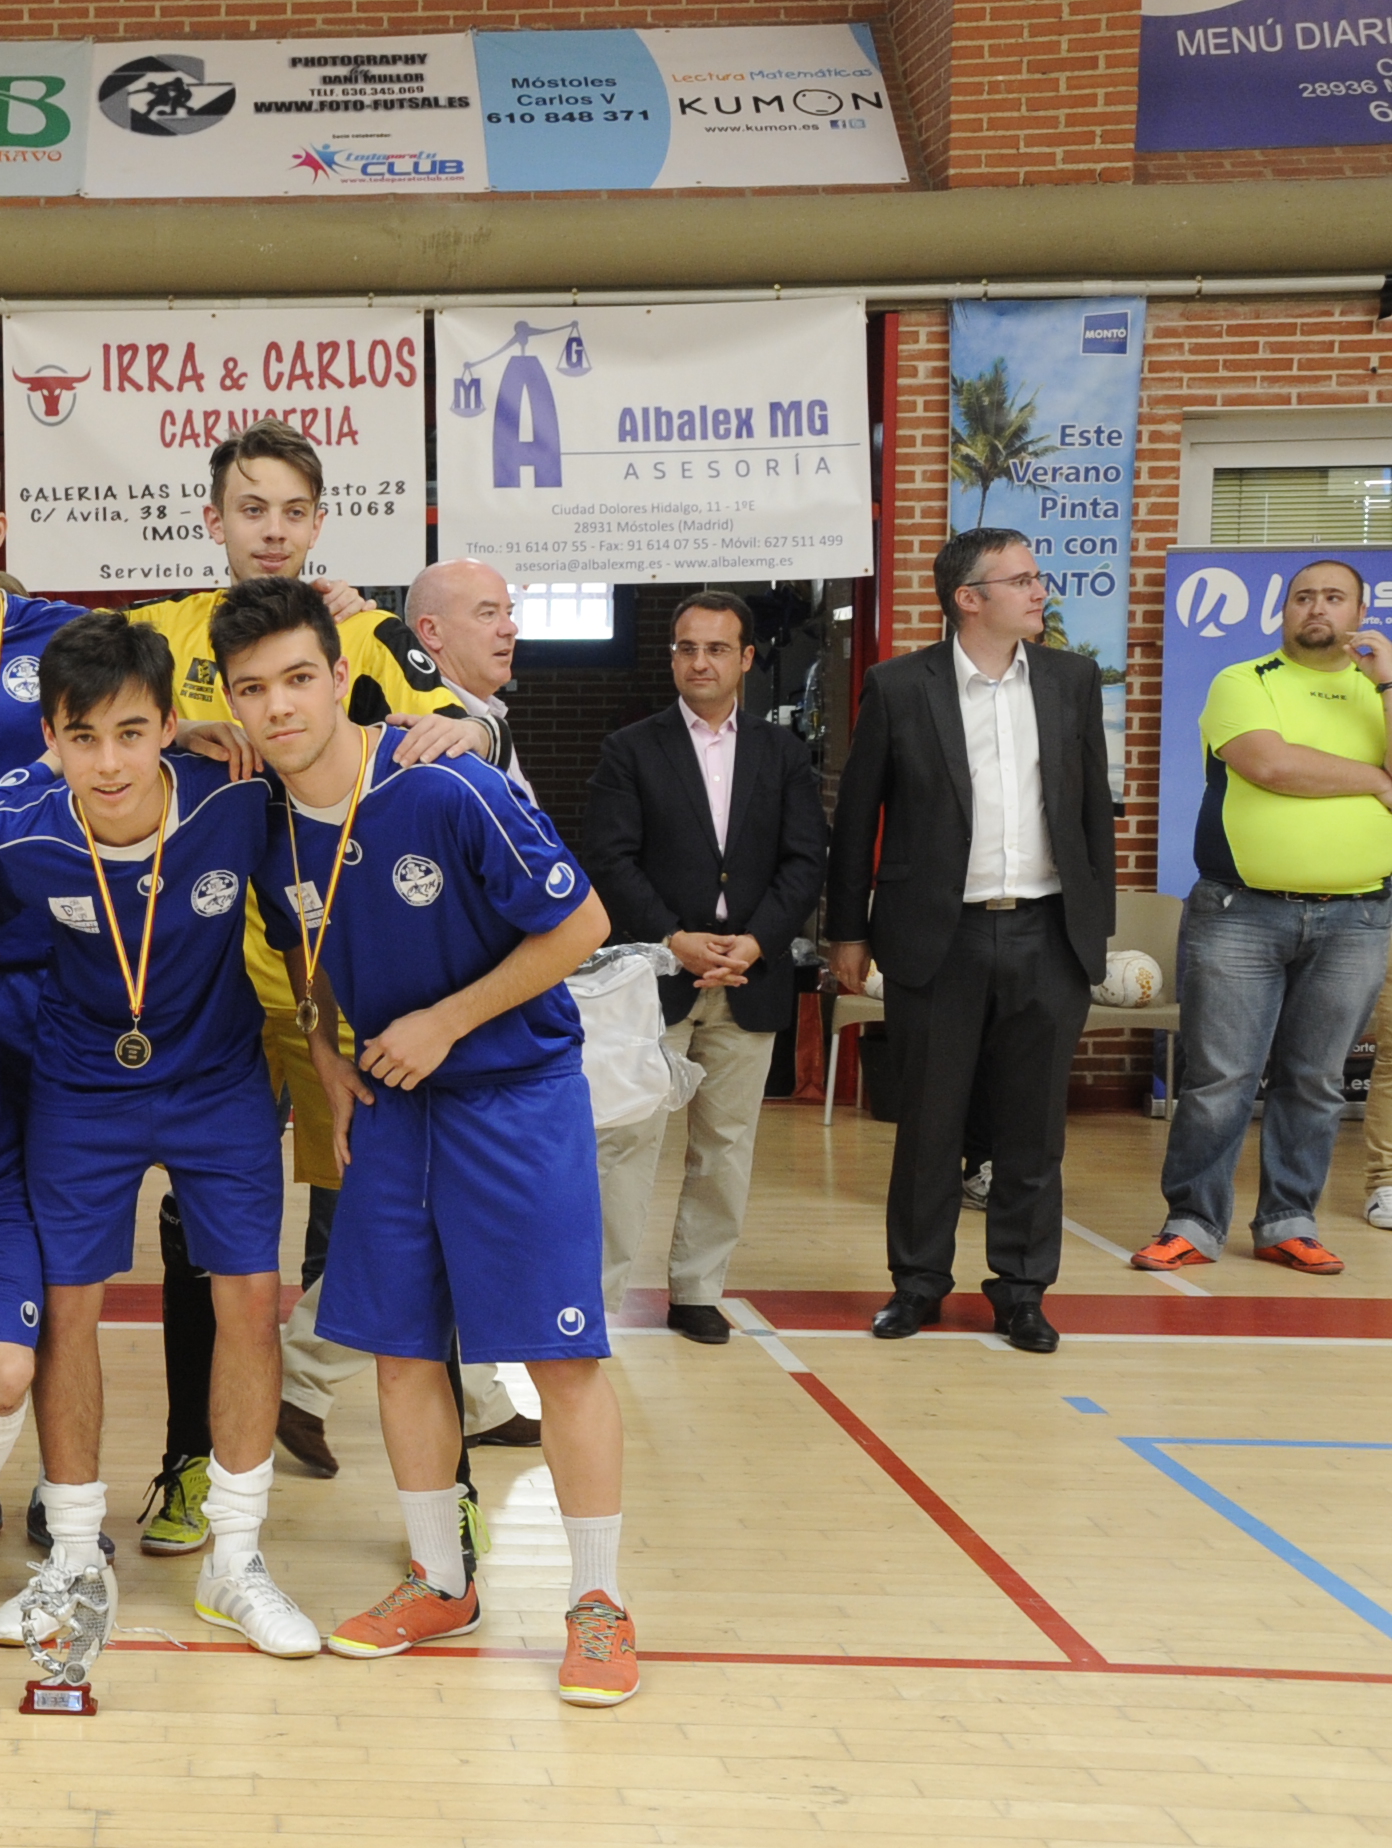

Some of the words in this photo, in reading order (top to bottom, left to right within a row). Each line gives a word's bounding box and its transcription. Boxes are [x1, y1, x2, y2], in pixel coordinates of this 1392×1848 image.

[1177, 18, 1283, 56] MENÚ
[290, 53, 428, 67] PHOTOGRAPHY
[322, 74, 358, 85] DANI
[363, 73, 425, 85] MULLOR
[511, 76, 617, 90] Móstoles
[672, 72, 745, 83] Lectura
[750, 68, 873, 81] Matemáticas
[309, 88, 339, 98] TELF.
[342, 86, 424, 97] 636.345.069
[1299, 79, 1378, 97] 28936
[253, 96, 470, 114] WWW.FOTO-FUTSAL.ES
[516, 92, 593, 107] Carlos
[601, 92, 617, 106] V
[678, 89, 884, 116] KUMON
[486, 111, 535, 124] 610
[544, 111, 593, 124] 848
[603, 109, 650, 122] 371
[1369, 101, 1392, 122] 6
[704, 123, 820, 133] www.kumon.es
[360, 159, 465, 177] CLUB
[1084, 327, 1127, 339] MONTÓ
[565, 337, 584, 368] G
[102, 342, 204, 392] IRRA
[220, 357, 248, 391] &
[263, 337, 417, 391] CARLOS
[454, 378, 481, 409] M
[618, 404, 755, 443] Albalex
[769, 399, 830, 438] MG
[1059, 424, 1123, 447] Este
[623, 453, 831, 481] ASESORÍA
[1011, 461, 1122, 483] Verano
[19, 486, 118, 502] GALERIA
[128, 484, 170, 499] LAS
[181, 483, 214, 499] LO
[377, 480, 407, 496] 28
[30, 507, 56, 523] C/
[140, 505, 168, 520] 38
[551, 503, 595, 516] Ciudad
[599, 503, 647, 515] Dolores
[651, 501, 702, 516] Hidalgo,
[707, 501, 721, 512] 11
[734, 500, 755, 512] 1ºE
[1041, 495, 1119, 519] Pinta
[142, 524, 213, 541] (MOS
[574, 521, 612, 534] 28931
[617, 520, 674, 533] Móstoles
[678, 518, 734, 534] (Madrid)
[466, 542, 503, 554] Tfno.:
[506, 542, 521, 553] 91
[525, 541, 548, 553] 614
[552, 541, 568, 553] 07
[572, 540, 587, 552] 55
[599, 540, 624, 552] Fax:
[627, 540, 642, 551] 91
[646, 539, 670, 551] 614
[674, 538, 689, 550] 07
[693, 538, 709, 550] 55
[721, 536, 760, 549] Móvil:
[764, 536, 788, 548] 627
[792, 536, 815, 548] 511
[819, 535, 843, 547] 499
[1064, 537, 1118, 555] con
[99, 564, 194, 580] Servicio
[202, 565, 214, 577] a
[515, 558, 663, 573] asesoria@albalexmg.es
[674, 555, 794, 570] www.albalexmg.es
[1310, 691, 1348, 700] KELME
